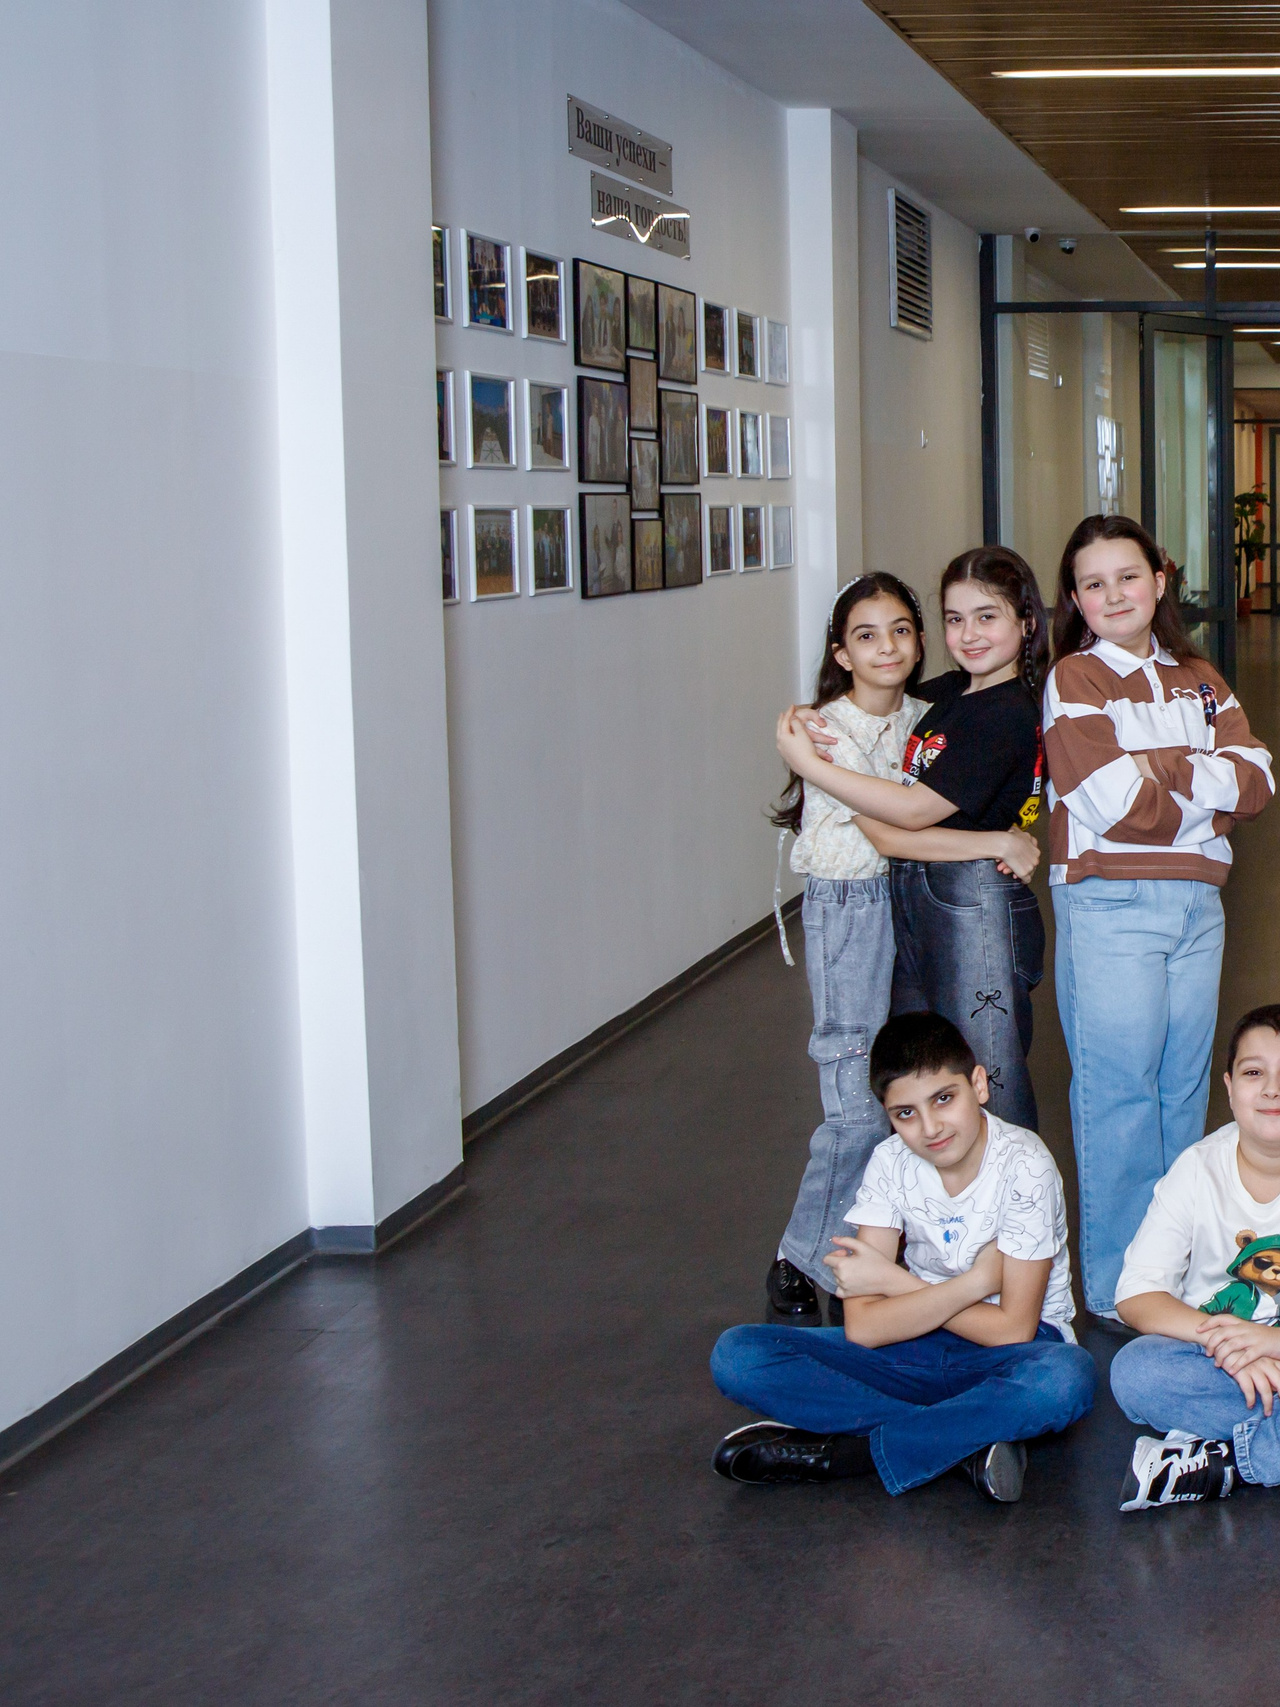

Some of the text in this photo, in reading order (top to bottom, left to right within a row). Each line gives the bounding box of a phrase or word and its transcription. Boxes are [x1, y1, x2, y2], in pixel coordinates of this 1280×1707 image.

[575, 106, 614, 154] Ваши
[615, 132, 657, 174] успехи
[596, 189, 687, 245] наша гордость!
